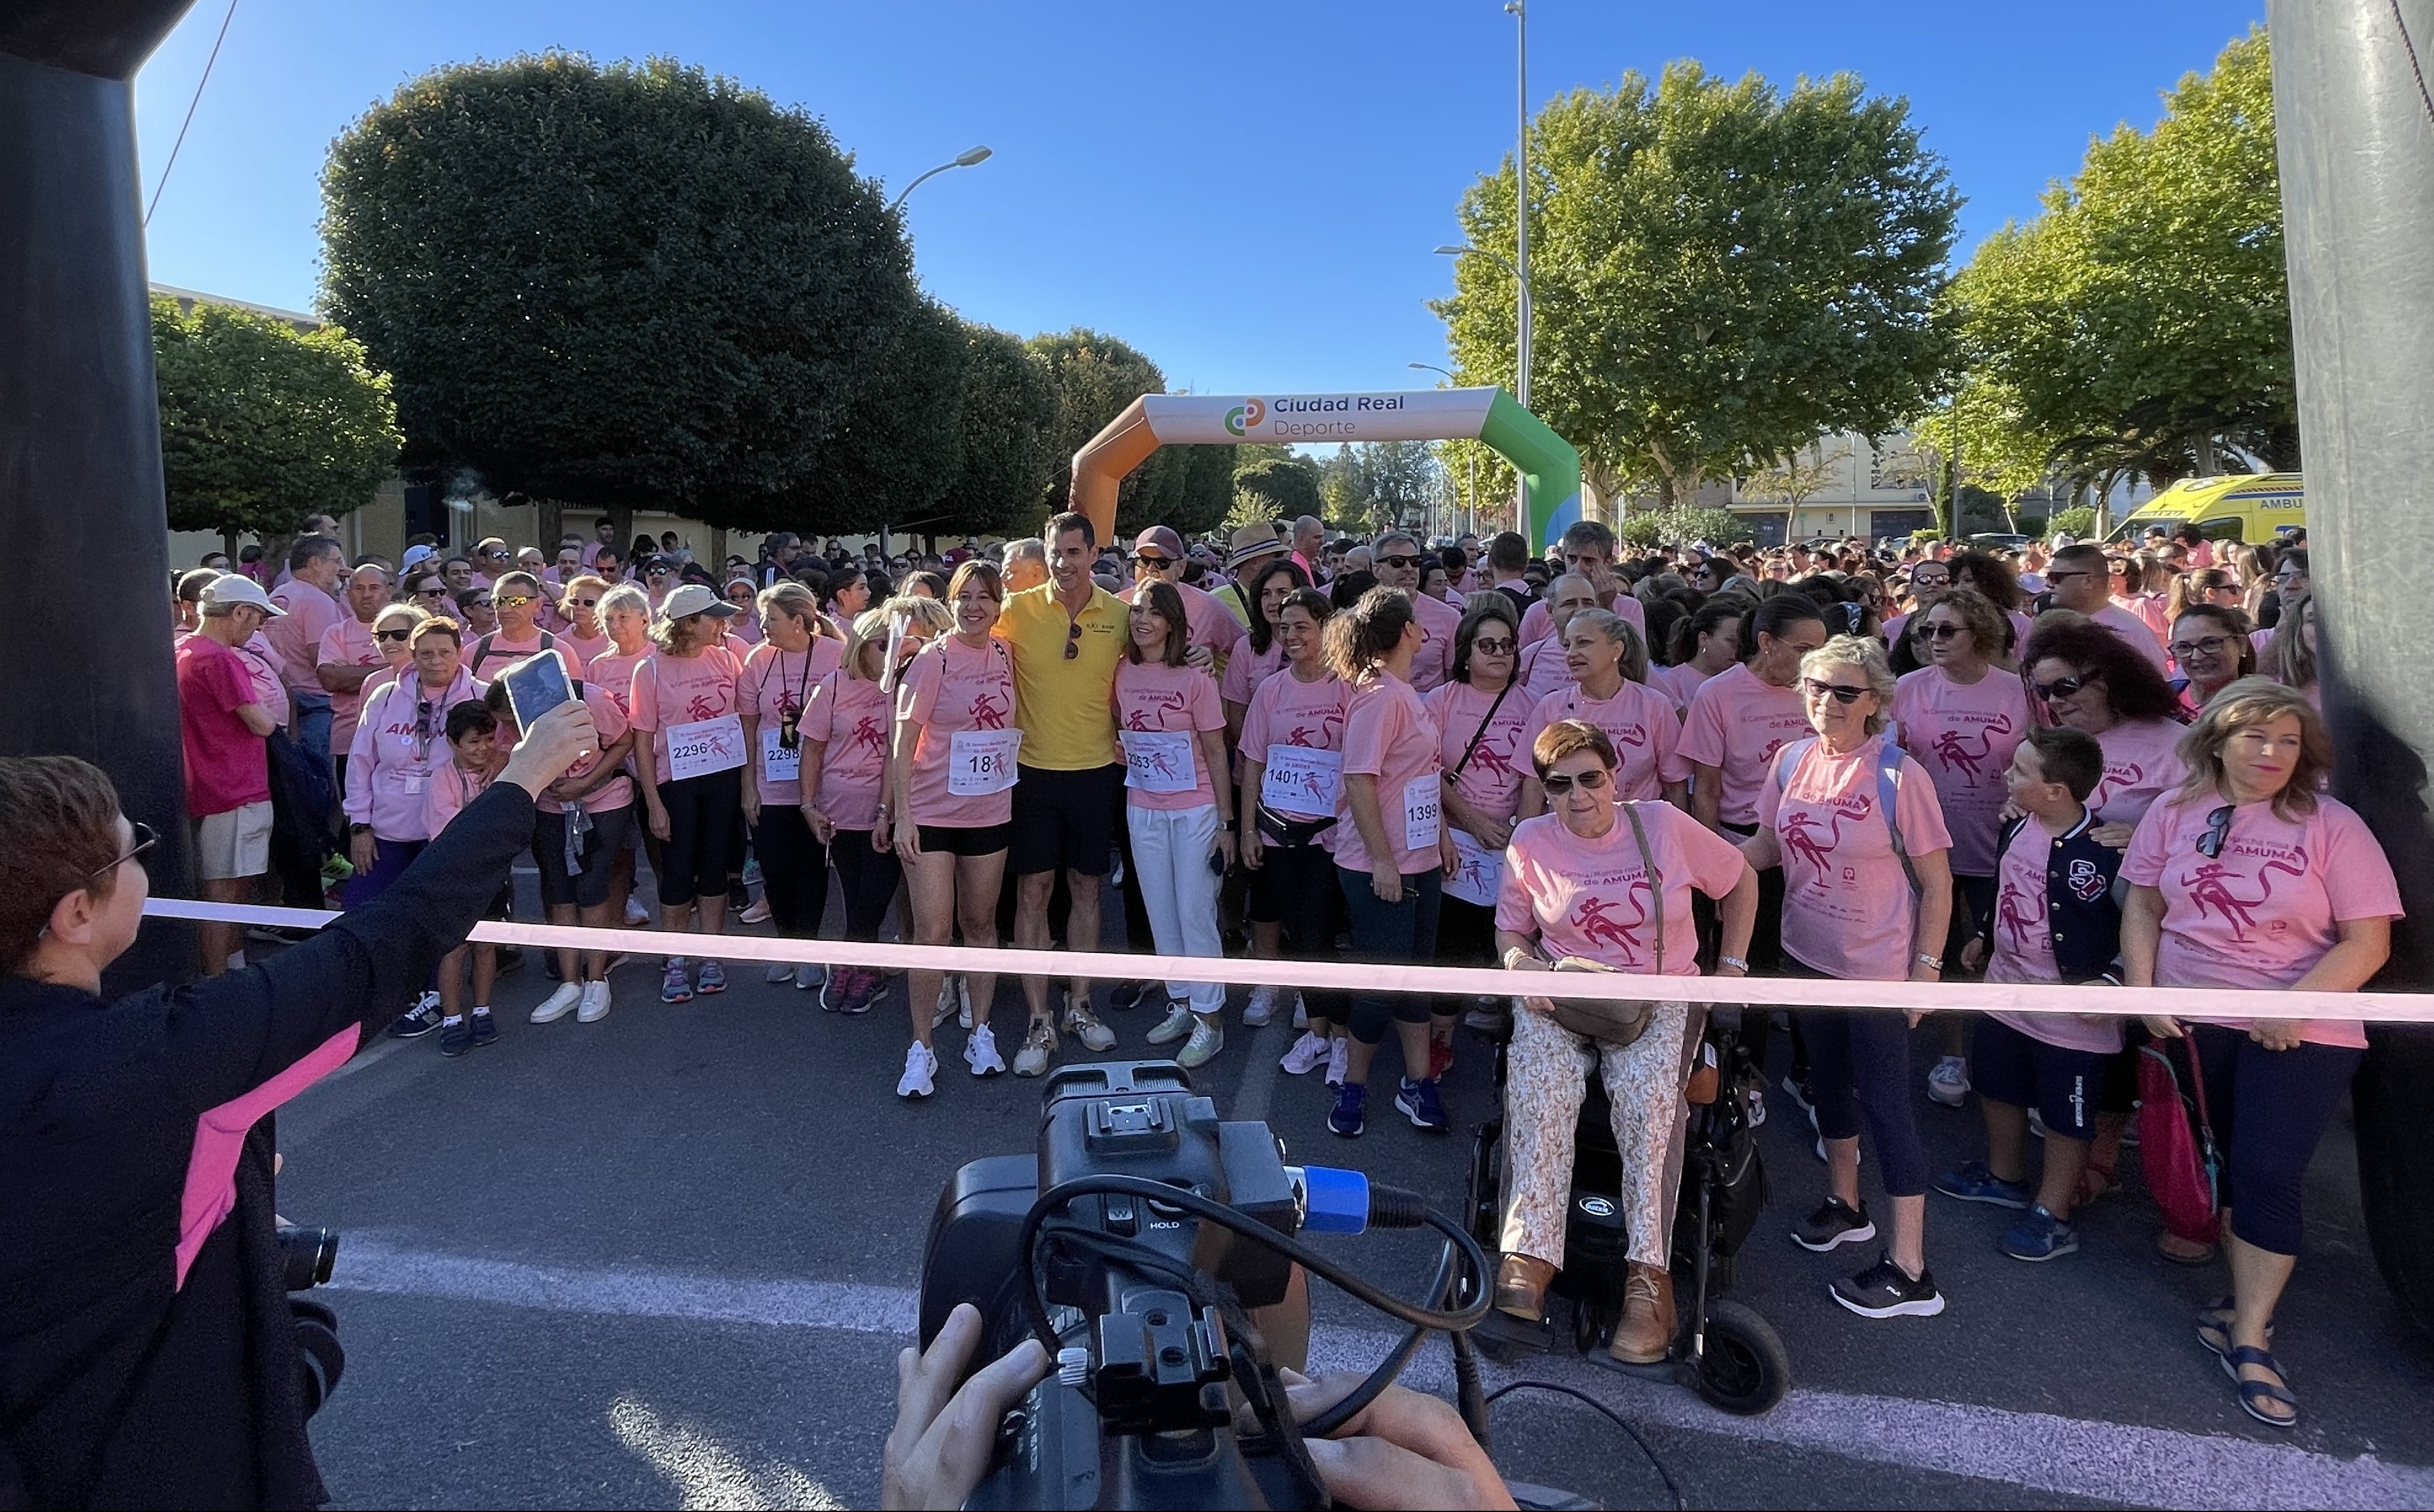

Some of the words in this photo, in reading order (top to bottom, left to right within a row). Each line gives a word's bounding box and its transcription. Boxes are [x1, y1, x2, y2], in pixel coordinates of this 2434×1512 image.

[1274, 397, 1349, 412] Ciudad
[1358, 395, 1403, 411] Real
[1274, 420, 1355, 436] Deporte
[1309, 707, 1341, 717] AMUMA
[1491, 718, 1526, 727] AMUMA
[1964, 716, 2003, 725] AMUMA
[673, 742, 707, 759] 2296
[768, 748, 799, 761] 2298
[969, 756, 991, 772] 18
[1269, 769, 1299, 785] 1401
[1803, 791, 1816, 801] de
[1818, 794, 1861, 810] AMUMA
[1408, 803, 1437, 821] 1399
[2233, 845, 2297, 862] AMUMA
[1603, 869, 1649, 885] AMUMA
[1112, 1209, 1128, 1218] W
